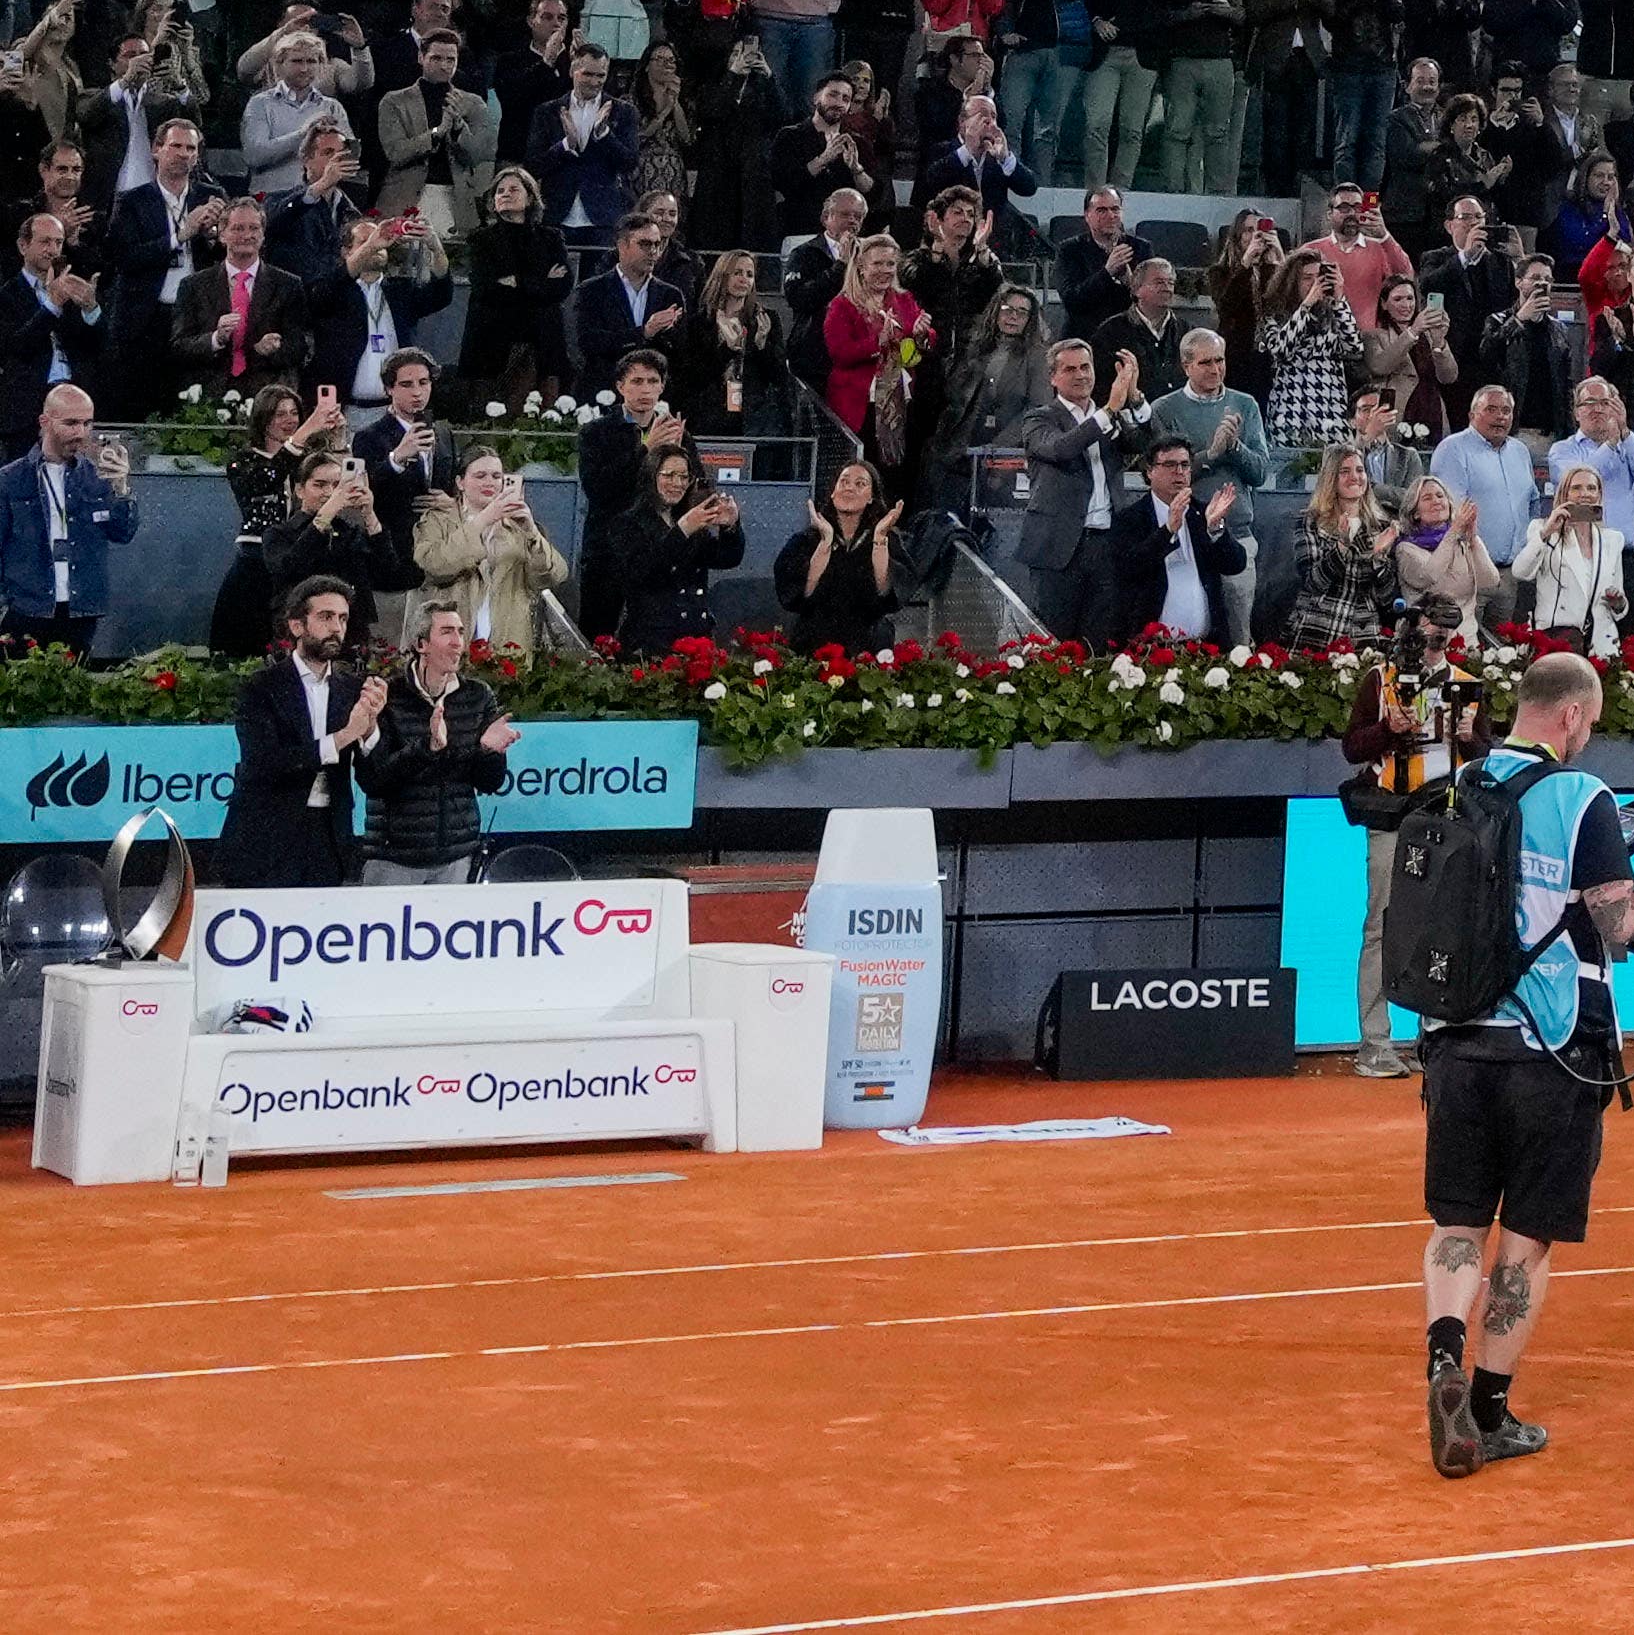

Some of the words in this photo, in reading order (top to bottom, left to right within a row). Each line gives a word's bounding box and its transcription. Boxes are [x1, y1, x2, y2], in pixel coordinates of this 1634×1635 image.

[122, 762, 240, 803] Iberd
[494, 756, 668, 797] erdrola
[1521, 856, 1559, 879] STER
[848, 908, 923, 936] ISDIN
[204, 901, 565, 982] Openbank
[857, 973, 907, 987] MAGIC
[1091, 978, 1270, 1011] LACOSTE
[861, 996, 881, 1024] 5
[858, 1026, 900, 1040] DAILY
[219, 1076, 412, 1123] Openbank
[466, 1066, 650, 1112] Openbank
